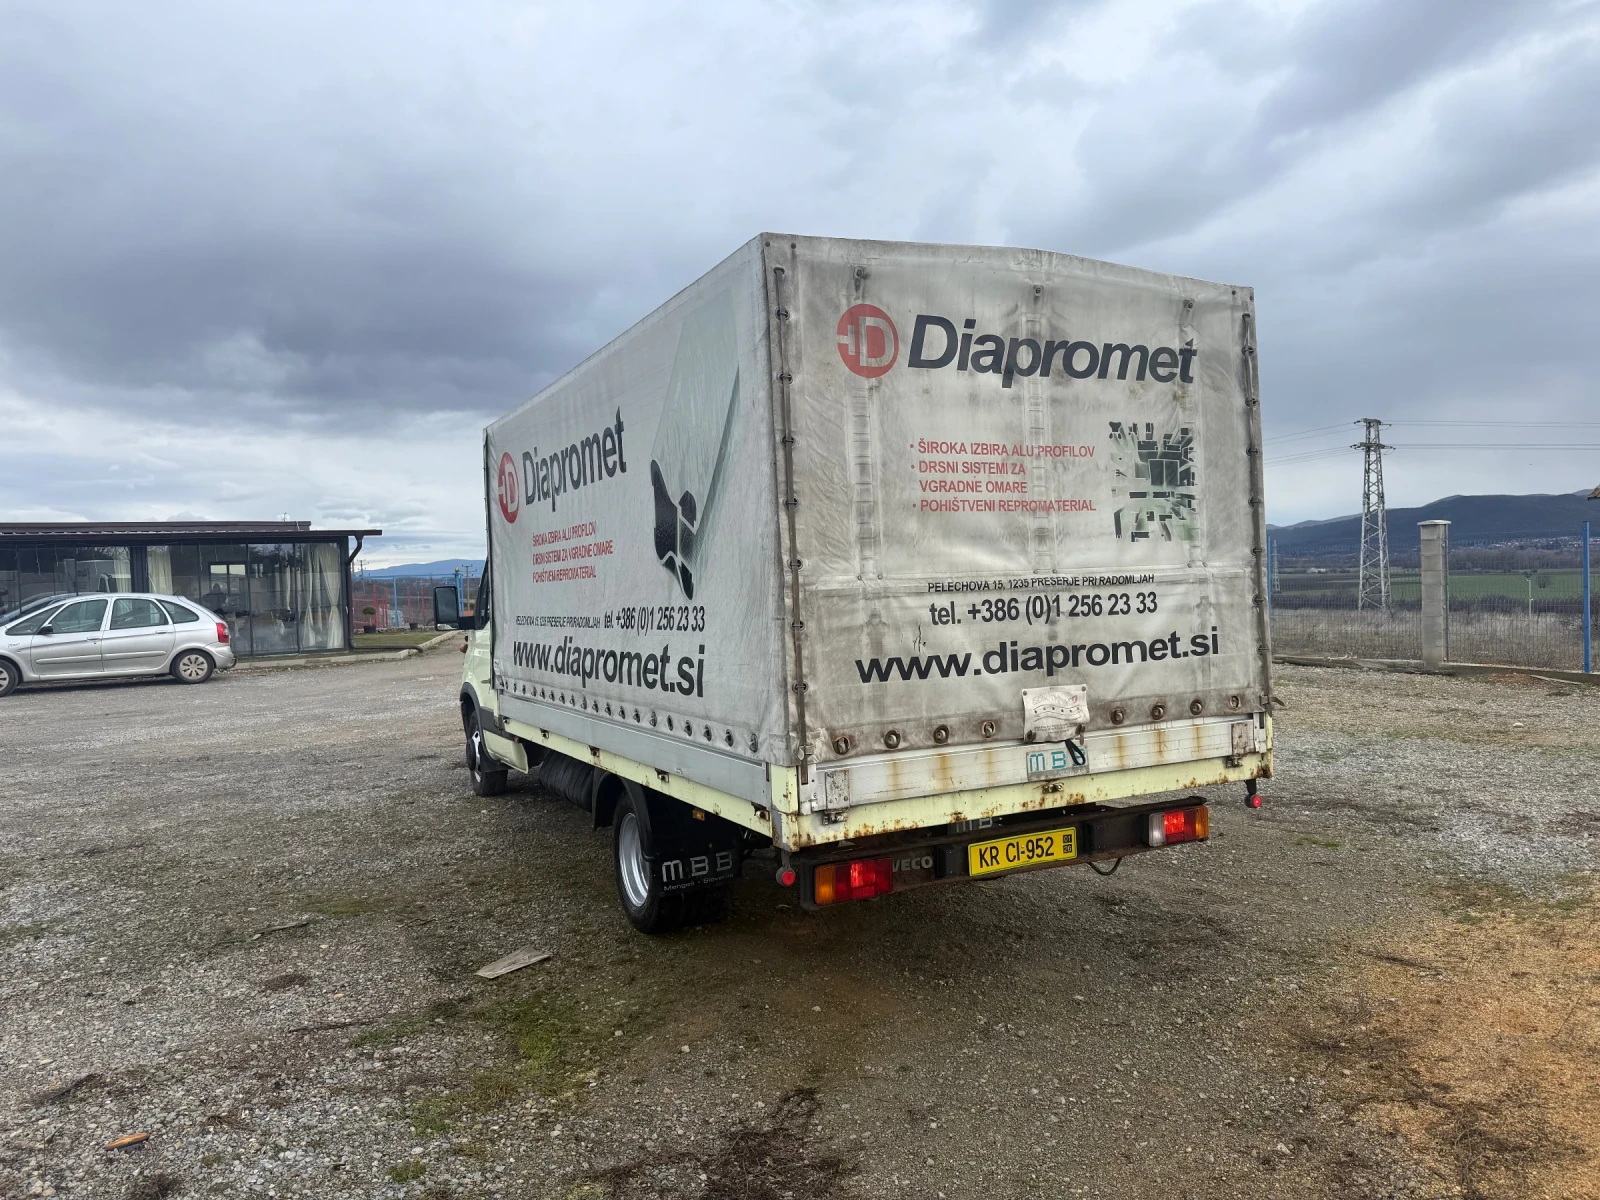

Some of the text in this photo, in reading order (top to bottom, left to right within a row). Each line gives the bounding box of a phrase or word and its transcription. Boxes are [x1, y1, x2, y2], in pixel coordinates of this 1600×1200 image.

[907, 313, 1198, 389] Diapromet
[917, 437, 1096, 458] ŠIROKA IZBIRA ALU PROFILOV
[522, 406, 627, 512] Diapromet
[918, 460, 1026, 476] DRSNI SISTEMI ZA
[918, 479, 1028, 494] VGRADNE OMARE
[920, 496, 1097, 513] POHIŠTVENI REPROMATERIAL
[593, 539, 614, 557] OMARE
[927, 573, 1155, 593] PELECHOVA 15, 1235 PRESERJE PRI RADOMLJAH
[929, 591, 1158, 626] tel. +386 (0)1 256 23 33
[604, 605, 706, 636] tel. +386 (0)1 256 23 33
[855, 626, 1219, 684] www.diapromet.si
[513, 635, 706, 698] www.diapromet.si
[892, 855, 934, 873] VECO
[979, 845, 1000, 869] KR
